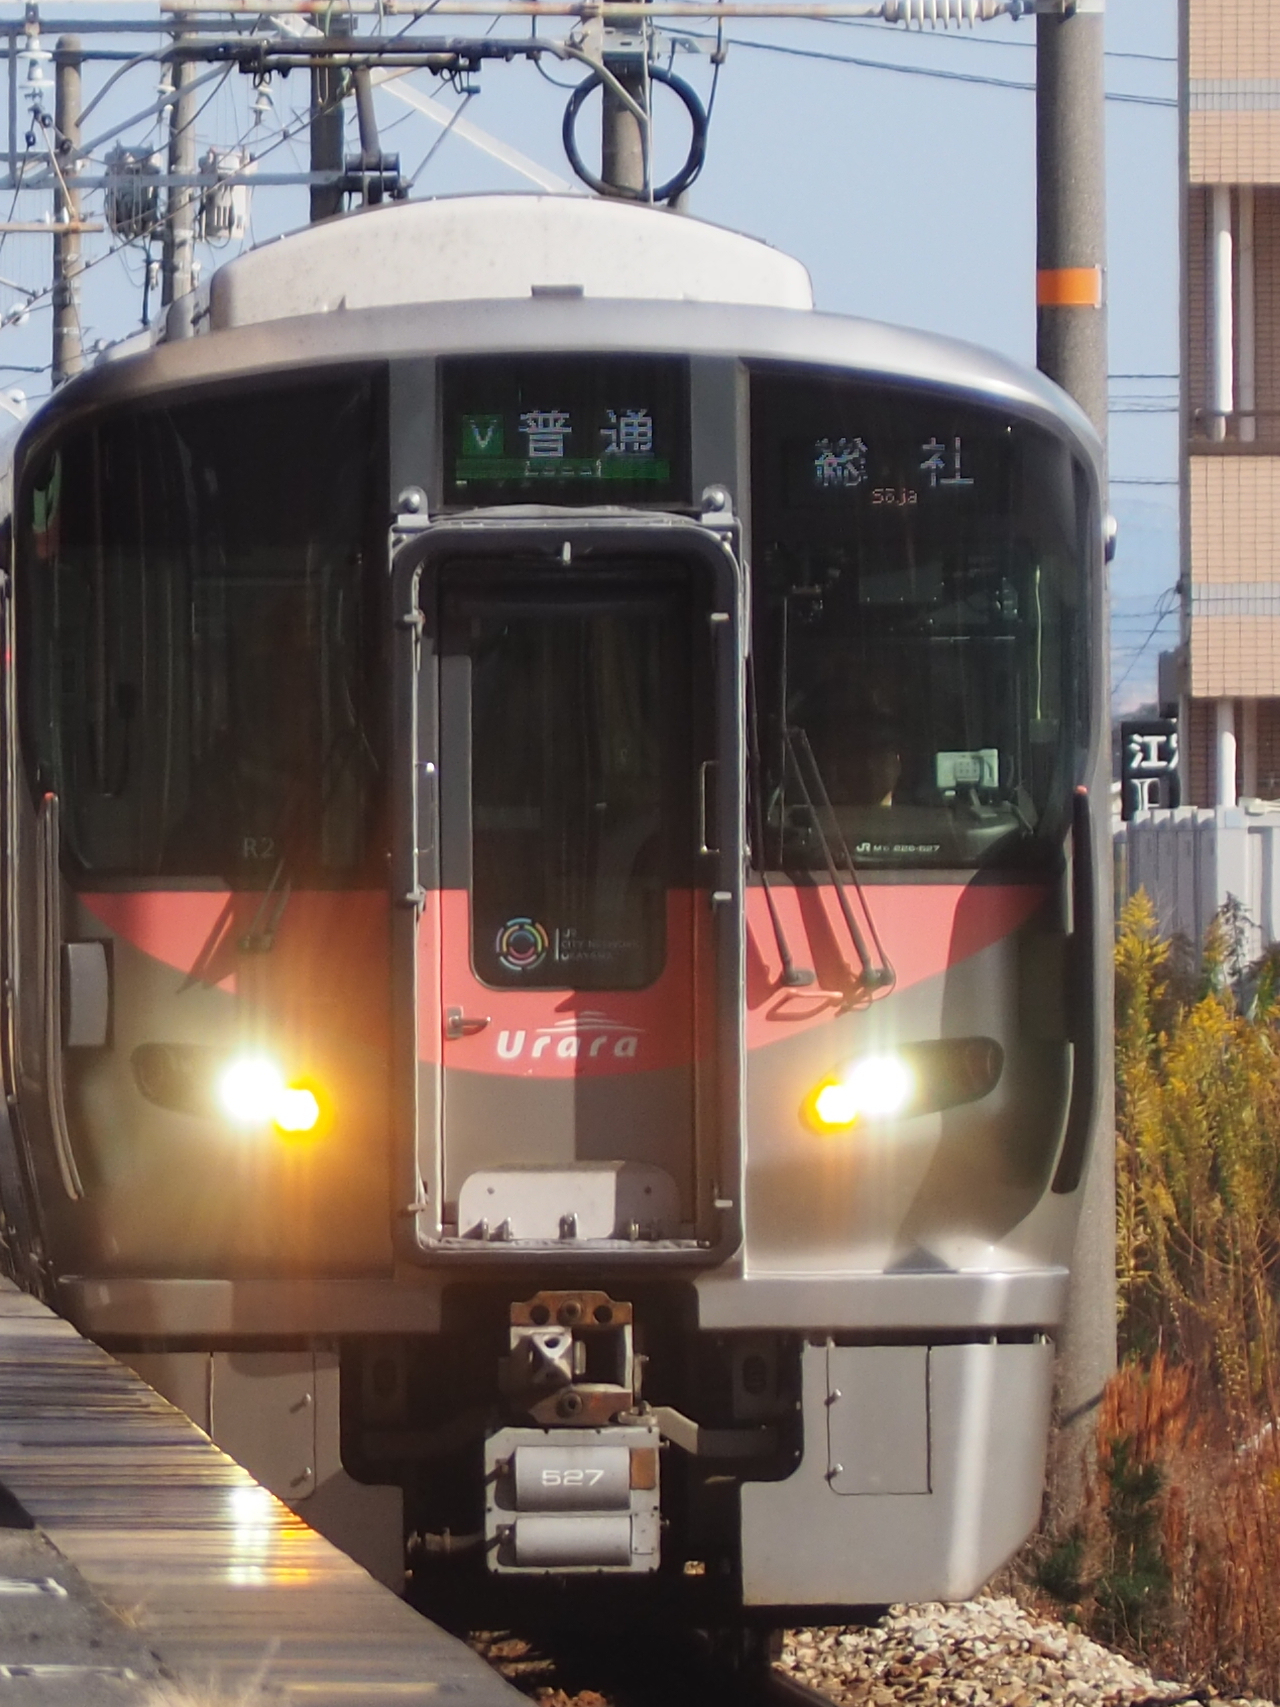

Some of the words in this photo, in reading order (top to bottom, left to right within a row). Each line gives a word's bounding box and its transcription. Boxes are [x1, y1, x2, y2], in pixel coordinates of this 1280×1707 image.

[470, 419, 497, 448] V
[518, 409, 654, 457] 普通
[243, 837, 275, 858] R2
[856, 842, 872, 853] JR
[496, 1030, 639, 1060] Urara
[541, 1469, 605, 1487] 527
